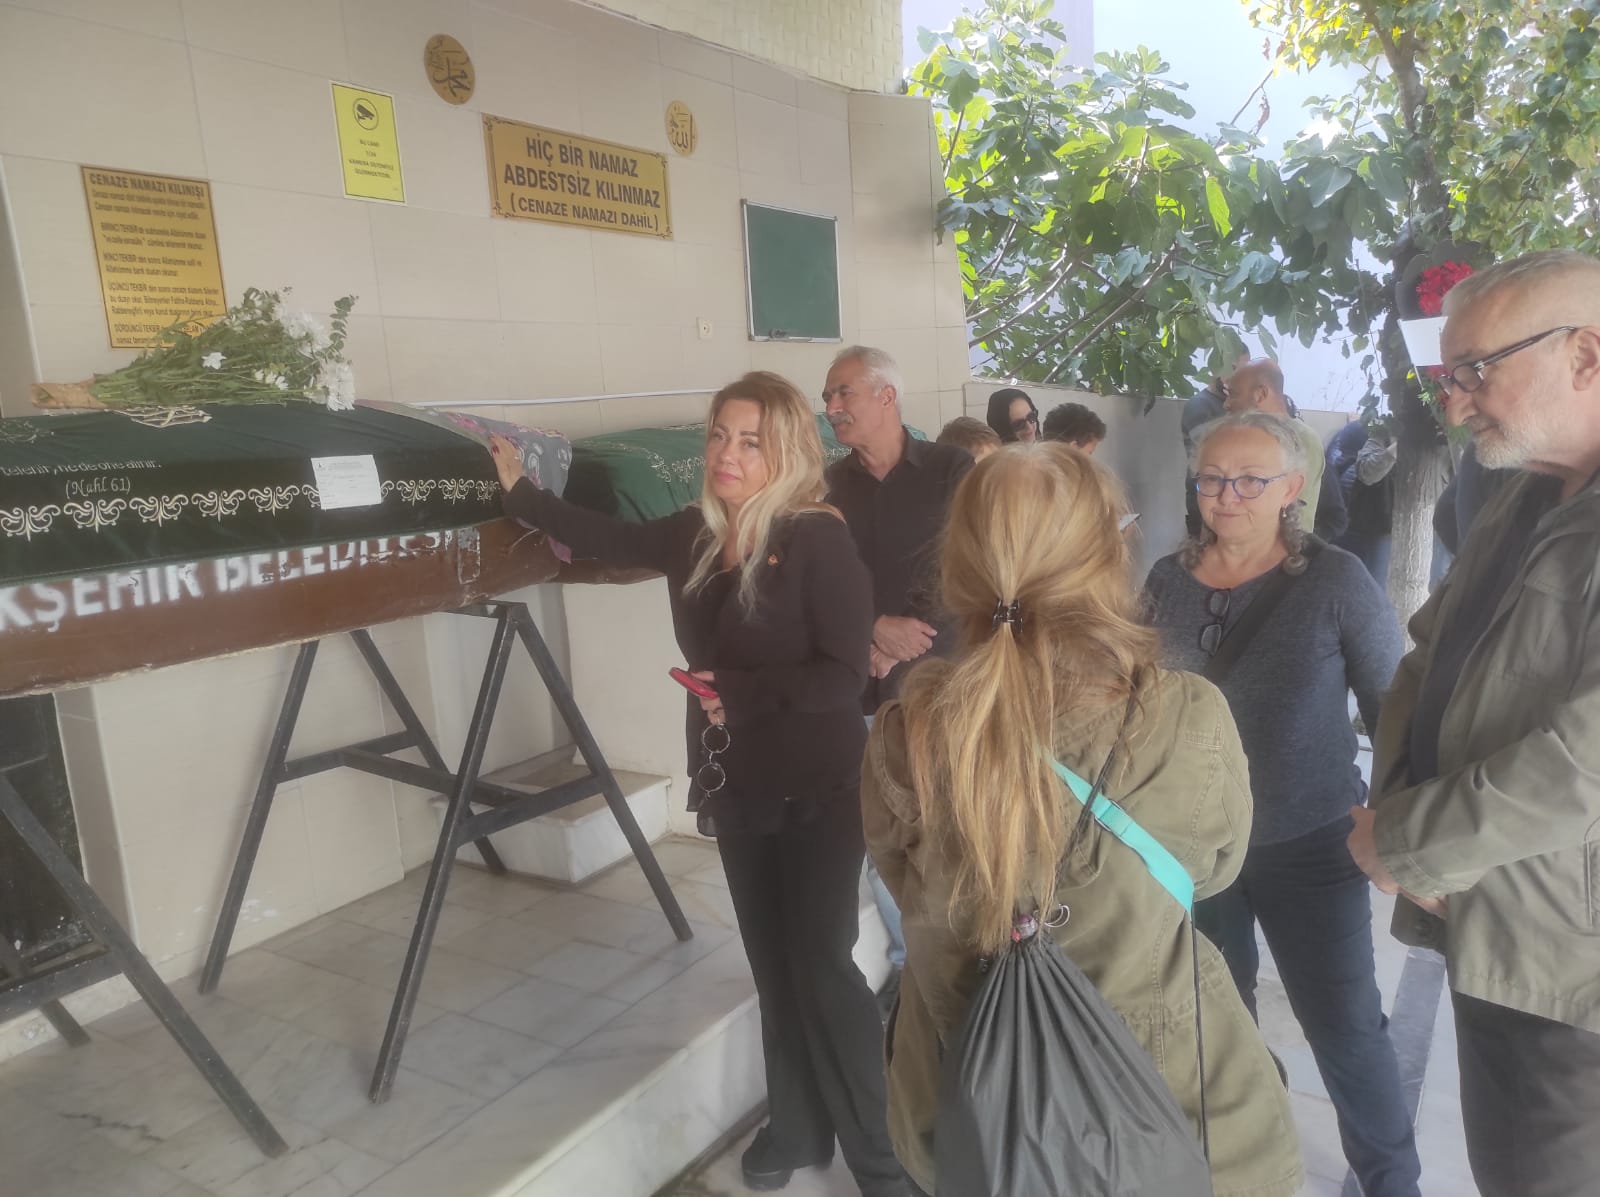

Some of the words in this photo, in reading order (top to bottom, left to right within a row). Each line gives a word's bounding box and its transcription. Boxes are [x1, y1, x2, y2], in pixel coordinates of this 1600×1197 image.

[526, 133, 553, 167] HİÇ
[559, 139, 584, 167] BİR
[589, 150, 639, 178] NAMAZ
[89, 173, 129, 189] CENAZE
[130, 178, 167, 193] NAMAZI
[504, 164, 591, 197] ABDESTSİZ
[596, 179, 661, 209] KILINMAZ
[518, 196, 568, 217] CENAZE
[572, 205, 618, 225] NAMAZI
[621, 212, 659, 232] DAHİL)
[66, 477, 107, 499] (Nahl
[110, 476, 131, 495] 61)
